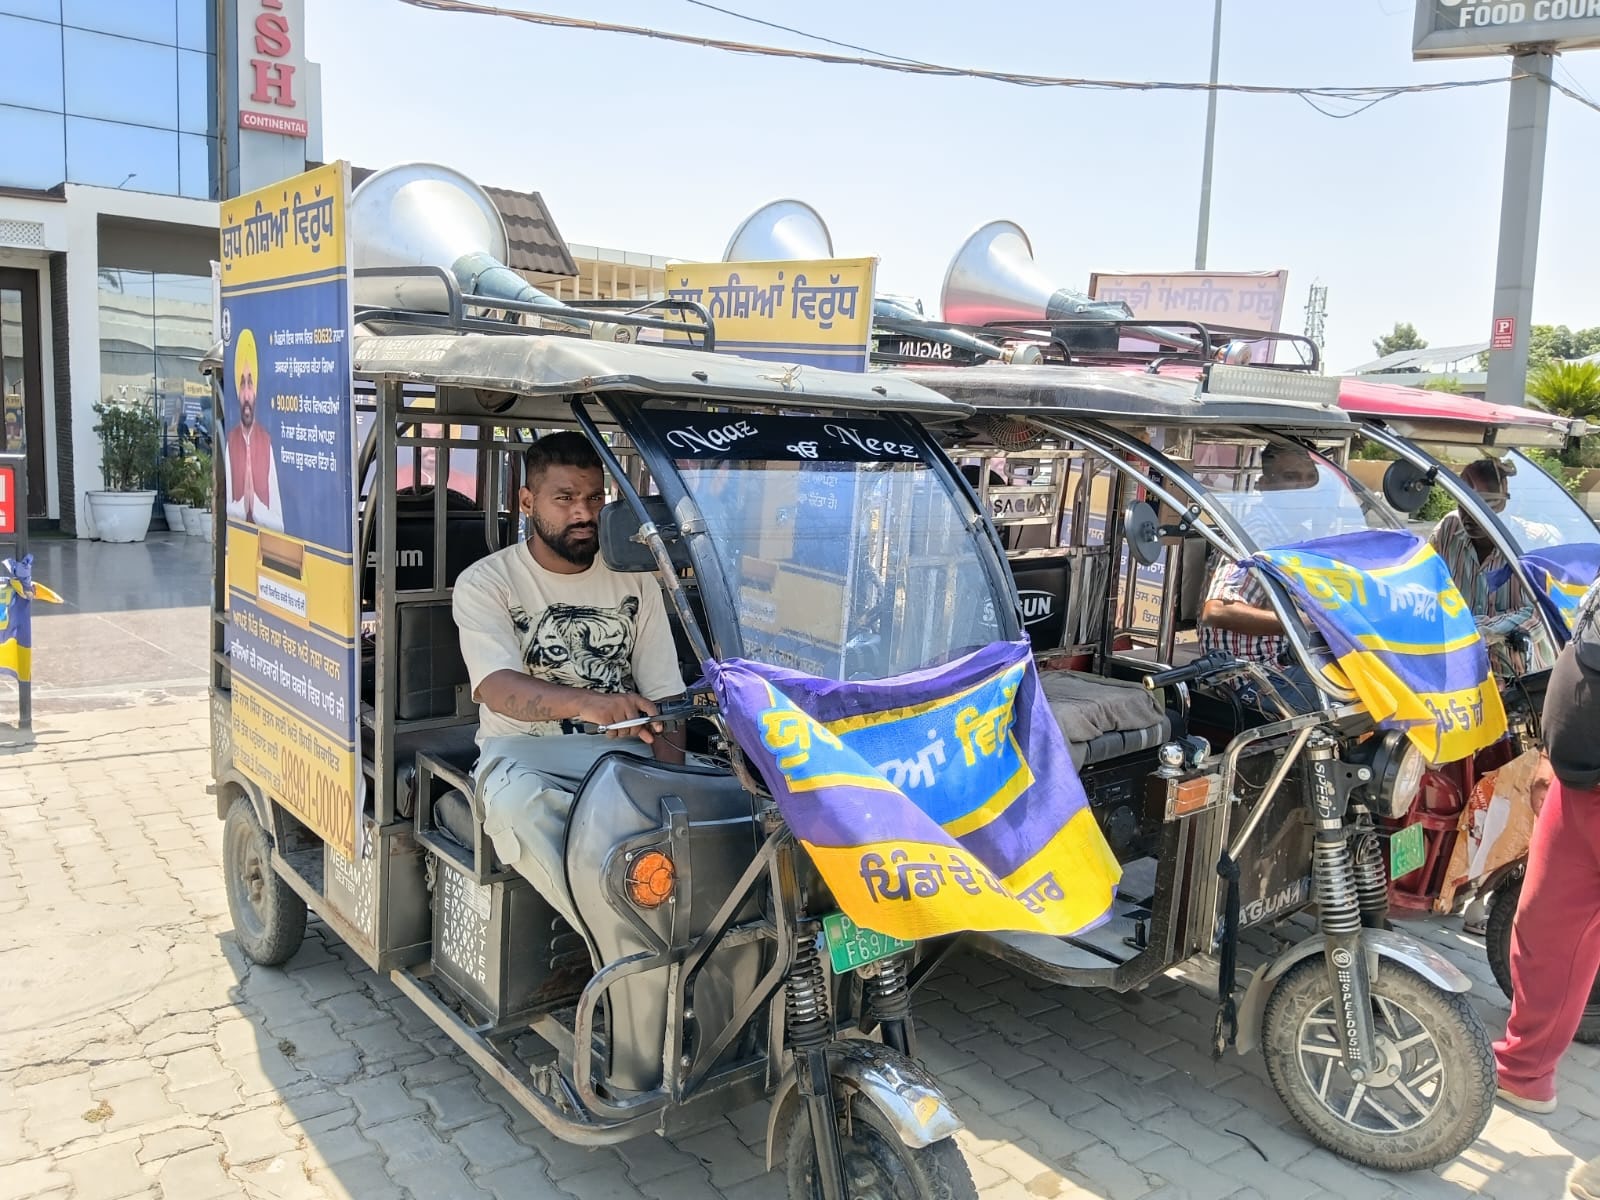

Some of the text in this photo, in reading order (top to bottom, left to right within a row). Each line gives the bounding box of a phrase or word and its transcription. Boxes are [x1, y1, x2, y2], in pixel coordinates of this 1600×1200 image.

[1459, 4, 1526, 28] FOOD
[250, 0, 296, 107] SH
[243, 114, 306, 133] CONTINENTAL
[222, 185, 334, 271] ਯੁੱਧ ਨਸ਼ਿਆਂ ਵਿਰੁੱਧ
[709, 271, 785, 318] ਨਸ਼ਿਆਂ
[792, 274, 859, 329] ਵਿਰੁੱਧ
[313, 328, 332, 343] 60632
[1499, 321, 1510, 333] P
[276, 394, 298, 413] 90,000
[666, 420, 758, 453] Naaz
[824, 424, 919, 459] Neez
[992, 497, 1052, 515] SAGUN
[281, 753, 353, 847] 98991-00002
[330, 848, 361, 886] NEELAM
[948, 854, 982, 895] ਦੇ
[442, 866, 452, 956] NEELAM
[478, 922, 488, 985] XTER
[1341, 983, 1358, 1046] SPEEDOS
